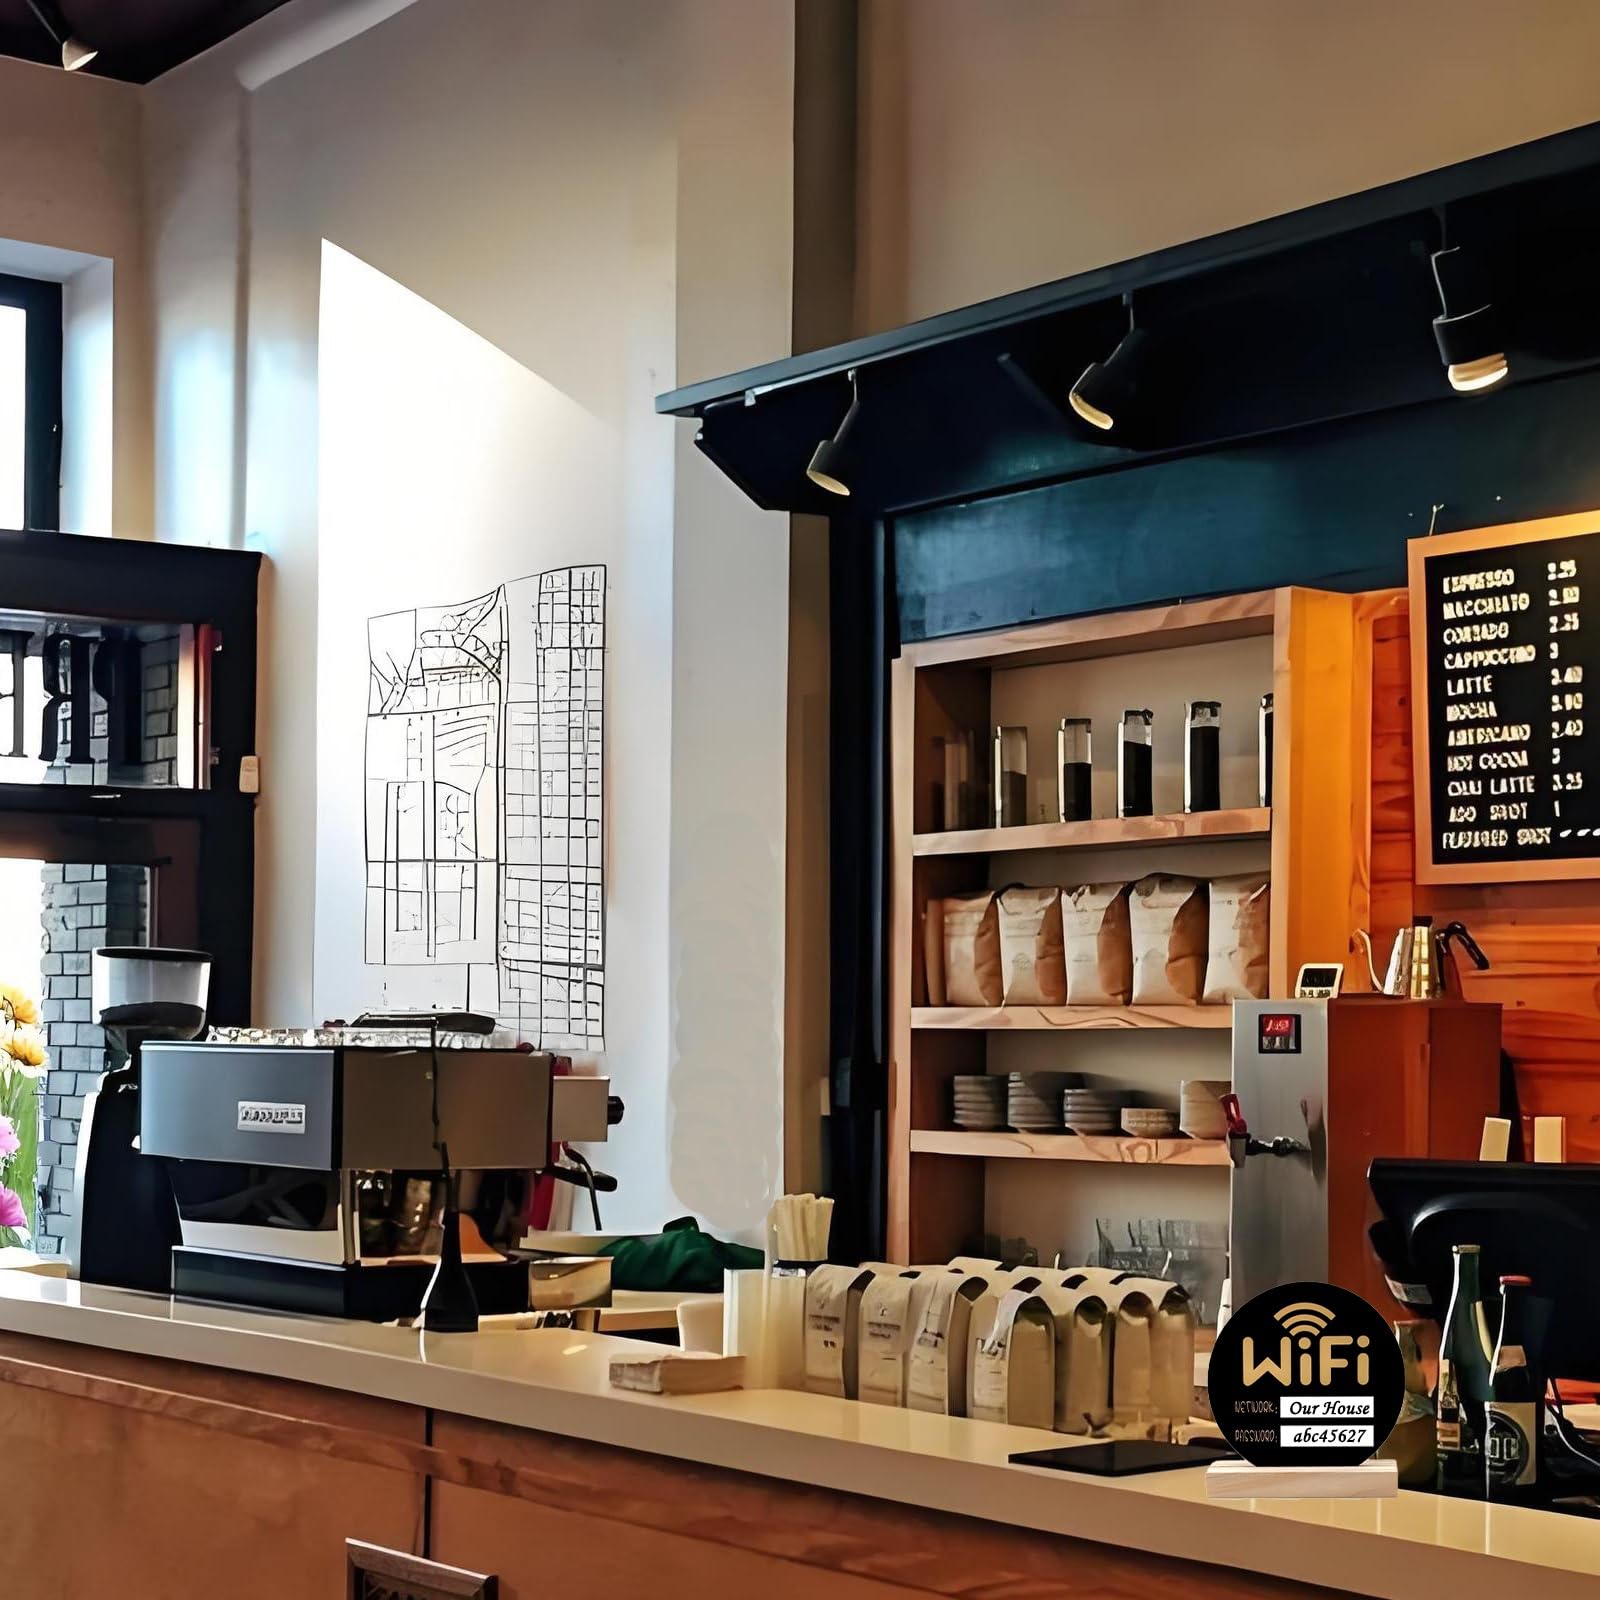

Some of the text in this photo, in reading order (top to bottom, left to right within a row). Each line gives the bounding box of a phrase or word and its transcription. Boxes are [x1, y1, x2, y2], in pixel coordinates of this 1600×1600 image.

[1447, 674, 1493, 696] LATTE
[1490, 775, 1536, 795] LATTE
[1242, 1335, 1370, 1387] WiFi
[1289, 1401, 1320, 1415] Our
[1322, 1400, 1370, 1415] House
[1293, 1427, 1367, 1443] abc45627
